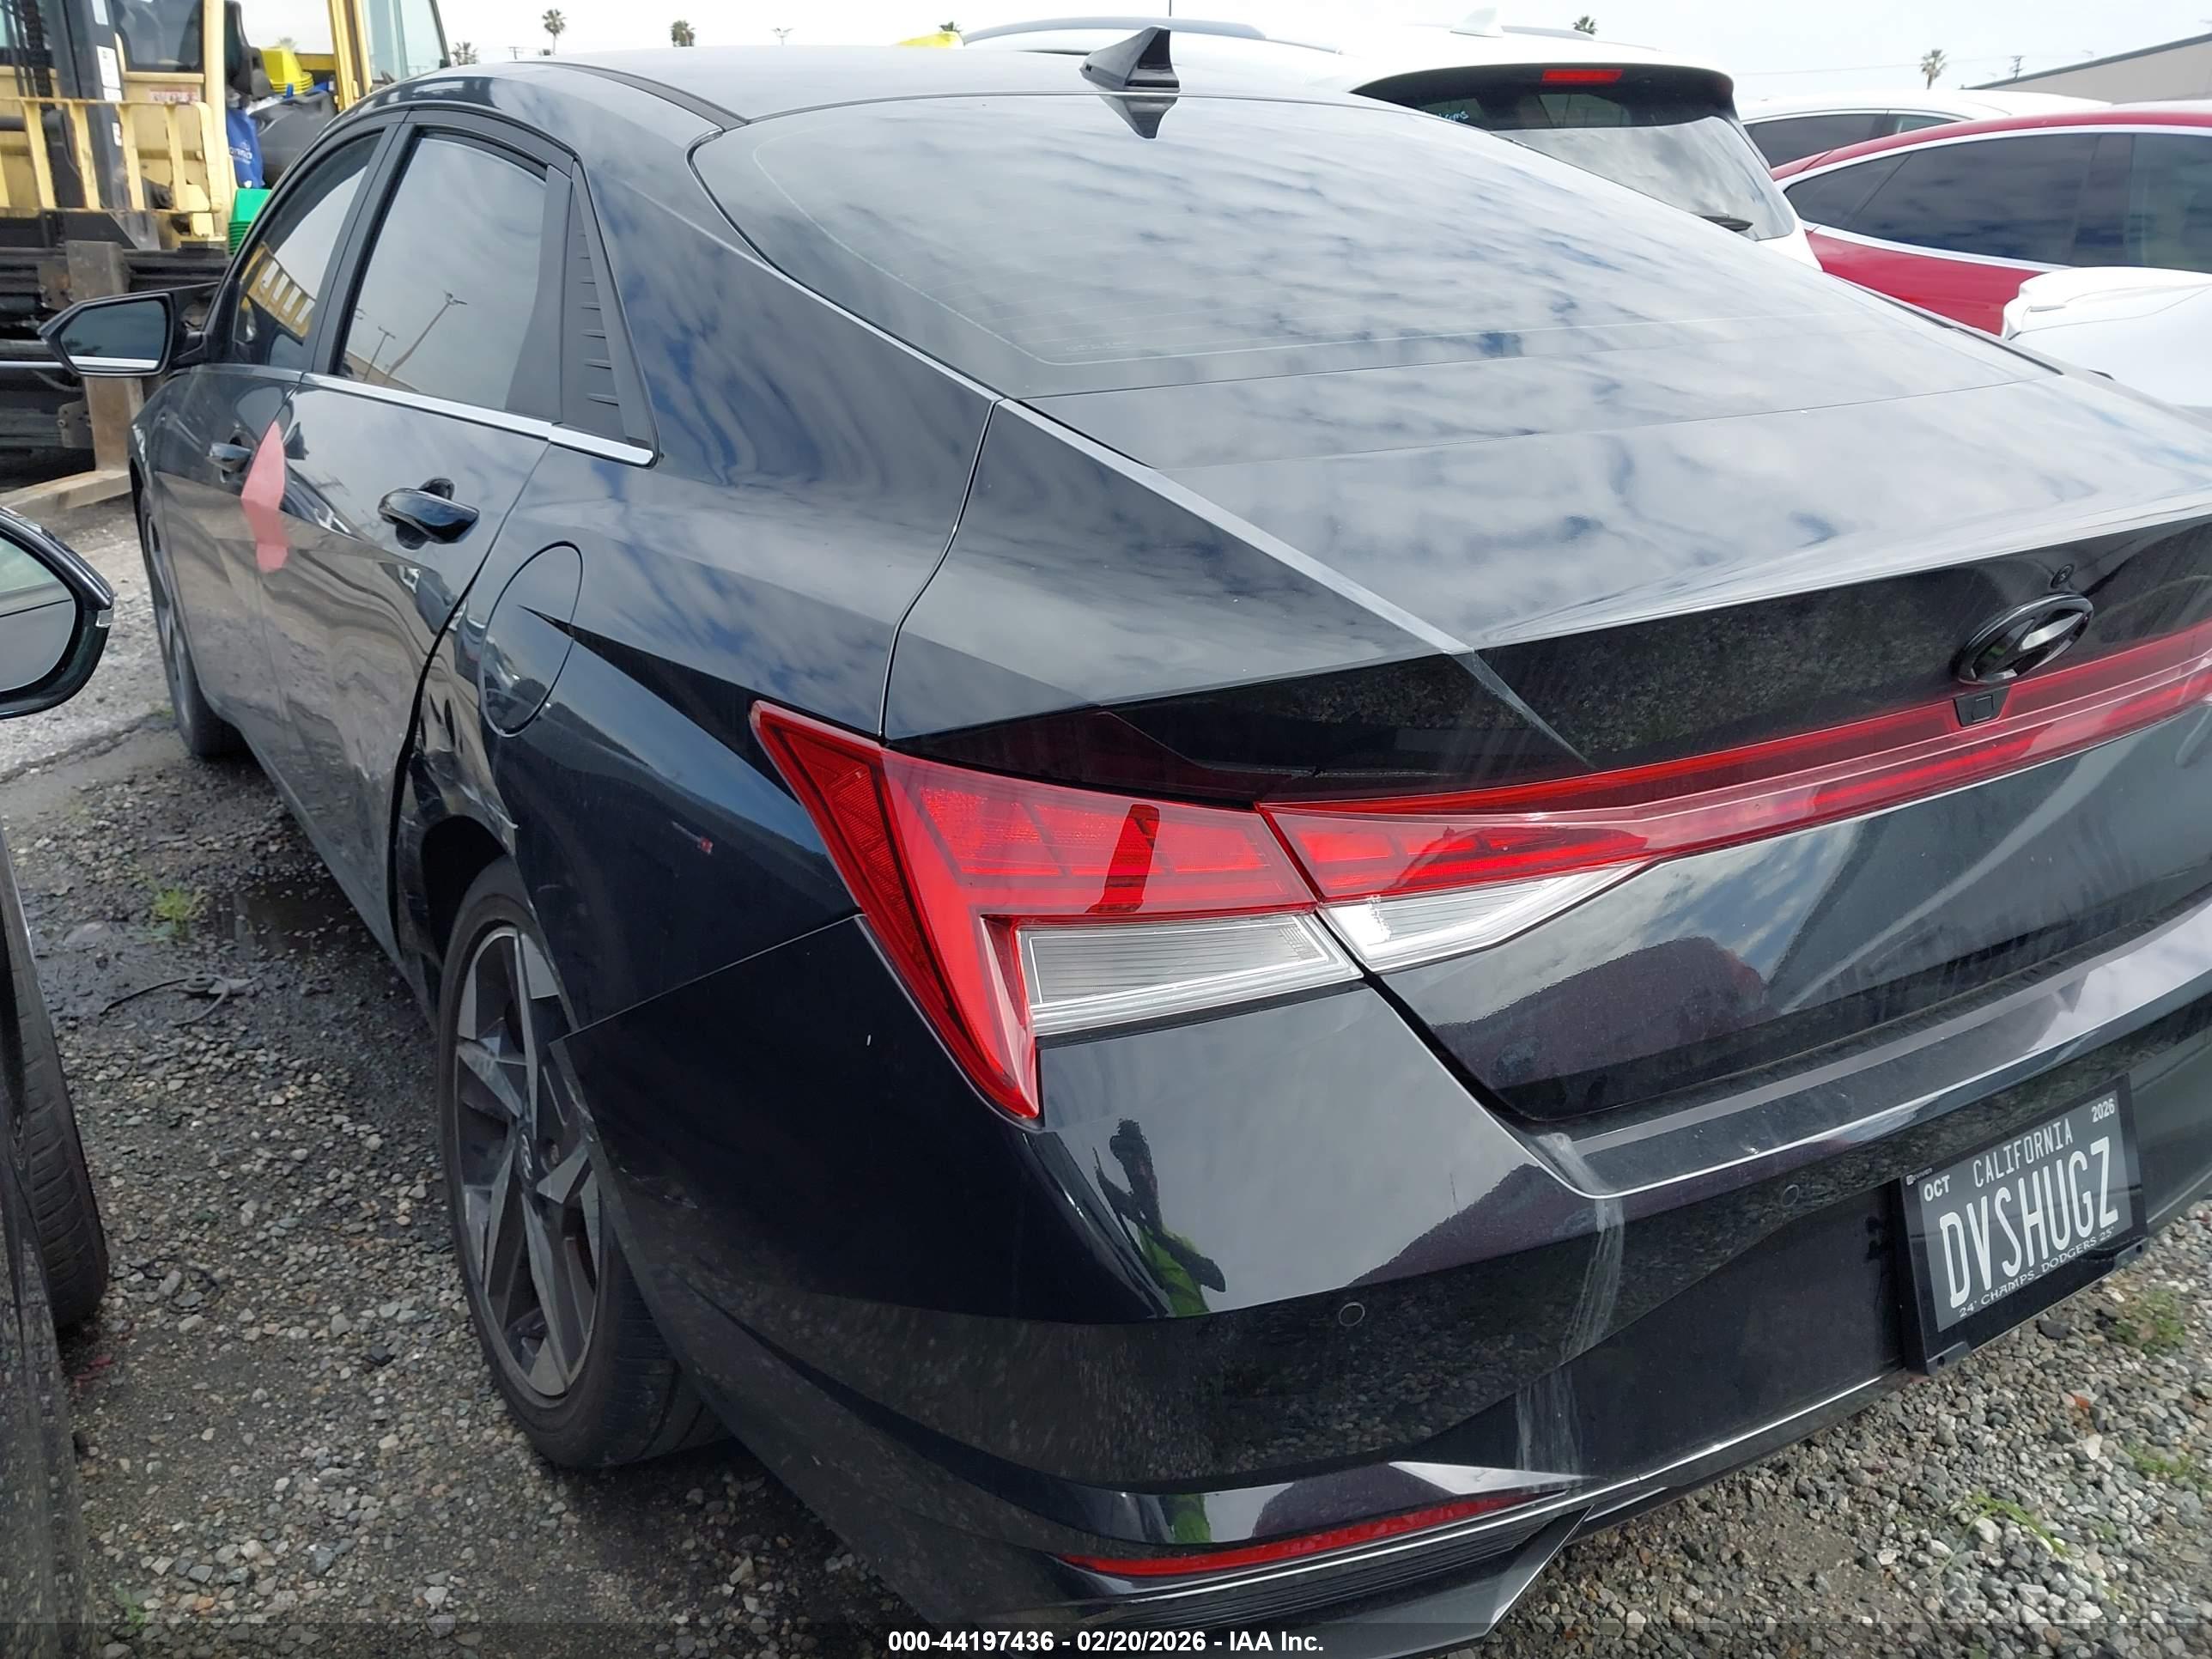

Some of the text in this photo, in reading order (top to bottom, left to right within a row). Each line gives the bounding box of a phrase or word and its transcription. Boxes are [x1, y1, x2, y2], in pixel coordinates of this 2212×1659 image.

[2091, 1098, 2115, 1122] 2026
[1973, 1118, 2074, 1187] CALIFORNIA
[1924, 1175, 1950, 1201] OCT
[1940, 1137, 2119, 1309] DVSHUGZ
